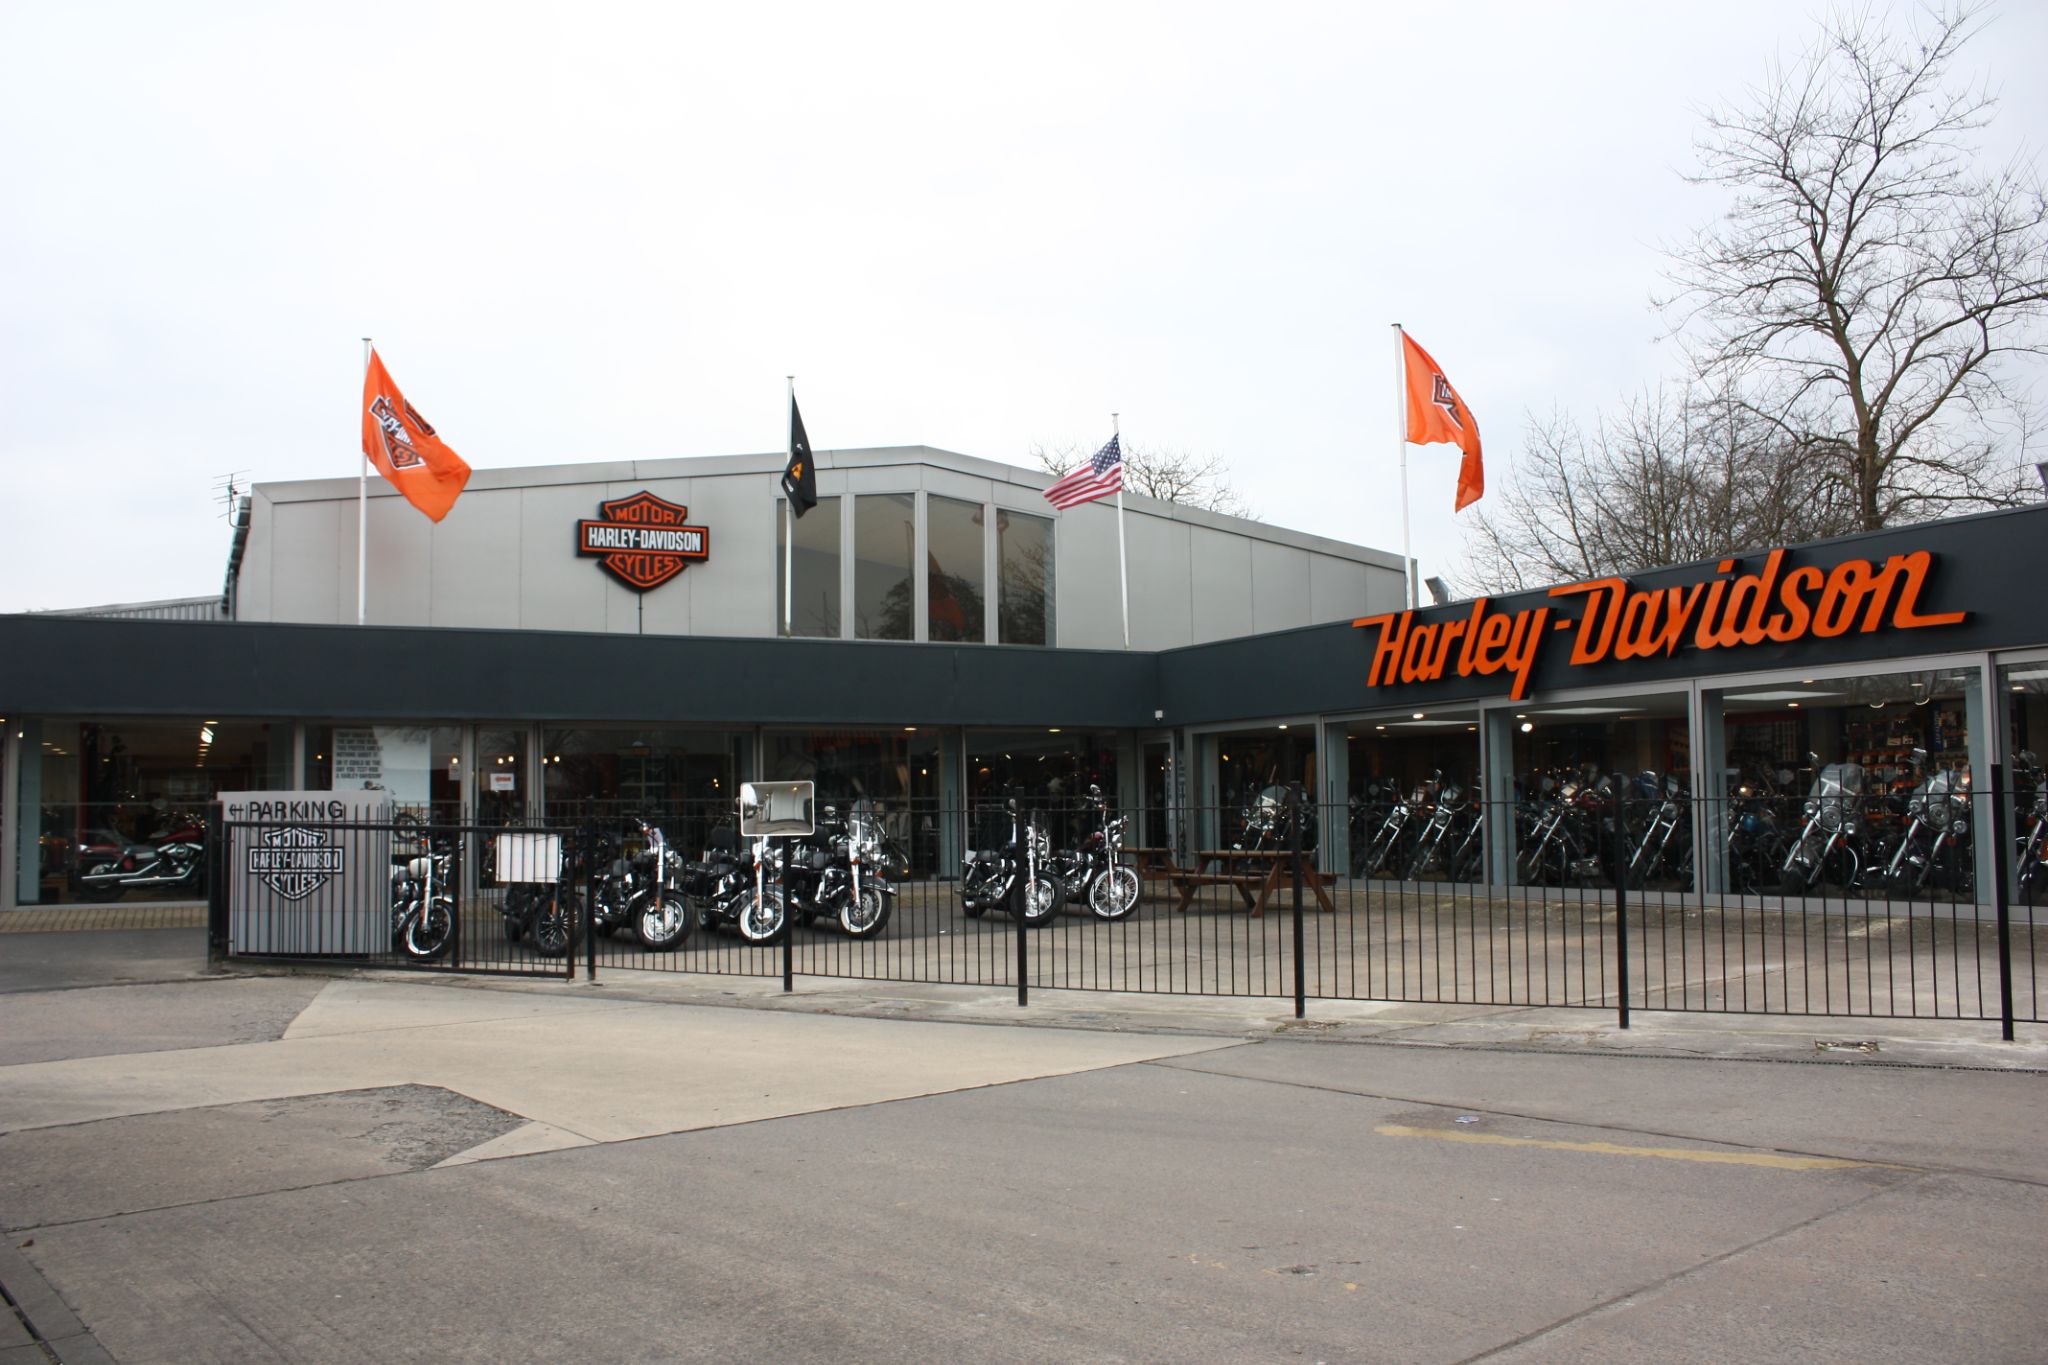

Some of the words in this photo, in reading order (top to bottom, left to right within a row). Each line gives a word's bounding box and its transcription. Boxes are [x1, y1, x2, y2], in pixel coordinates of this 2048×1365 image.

[615, 500, 675, 524] MOTOR
[588, 527, 701, 552] HARLEY-DAVIDSON
[613, 554, 675, 581] CYCLES
[1352, 548, 1969, 701] Harley-Davidson
[249, 800, 343, 819] PARKING
[272, 829, 318, 847] MOTOR
